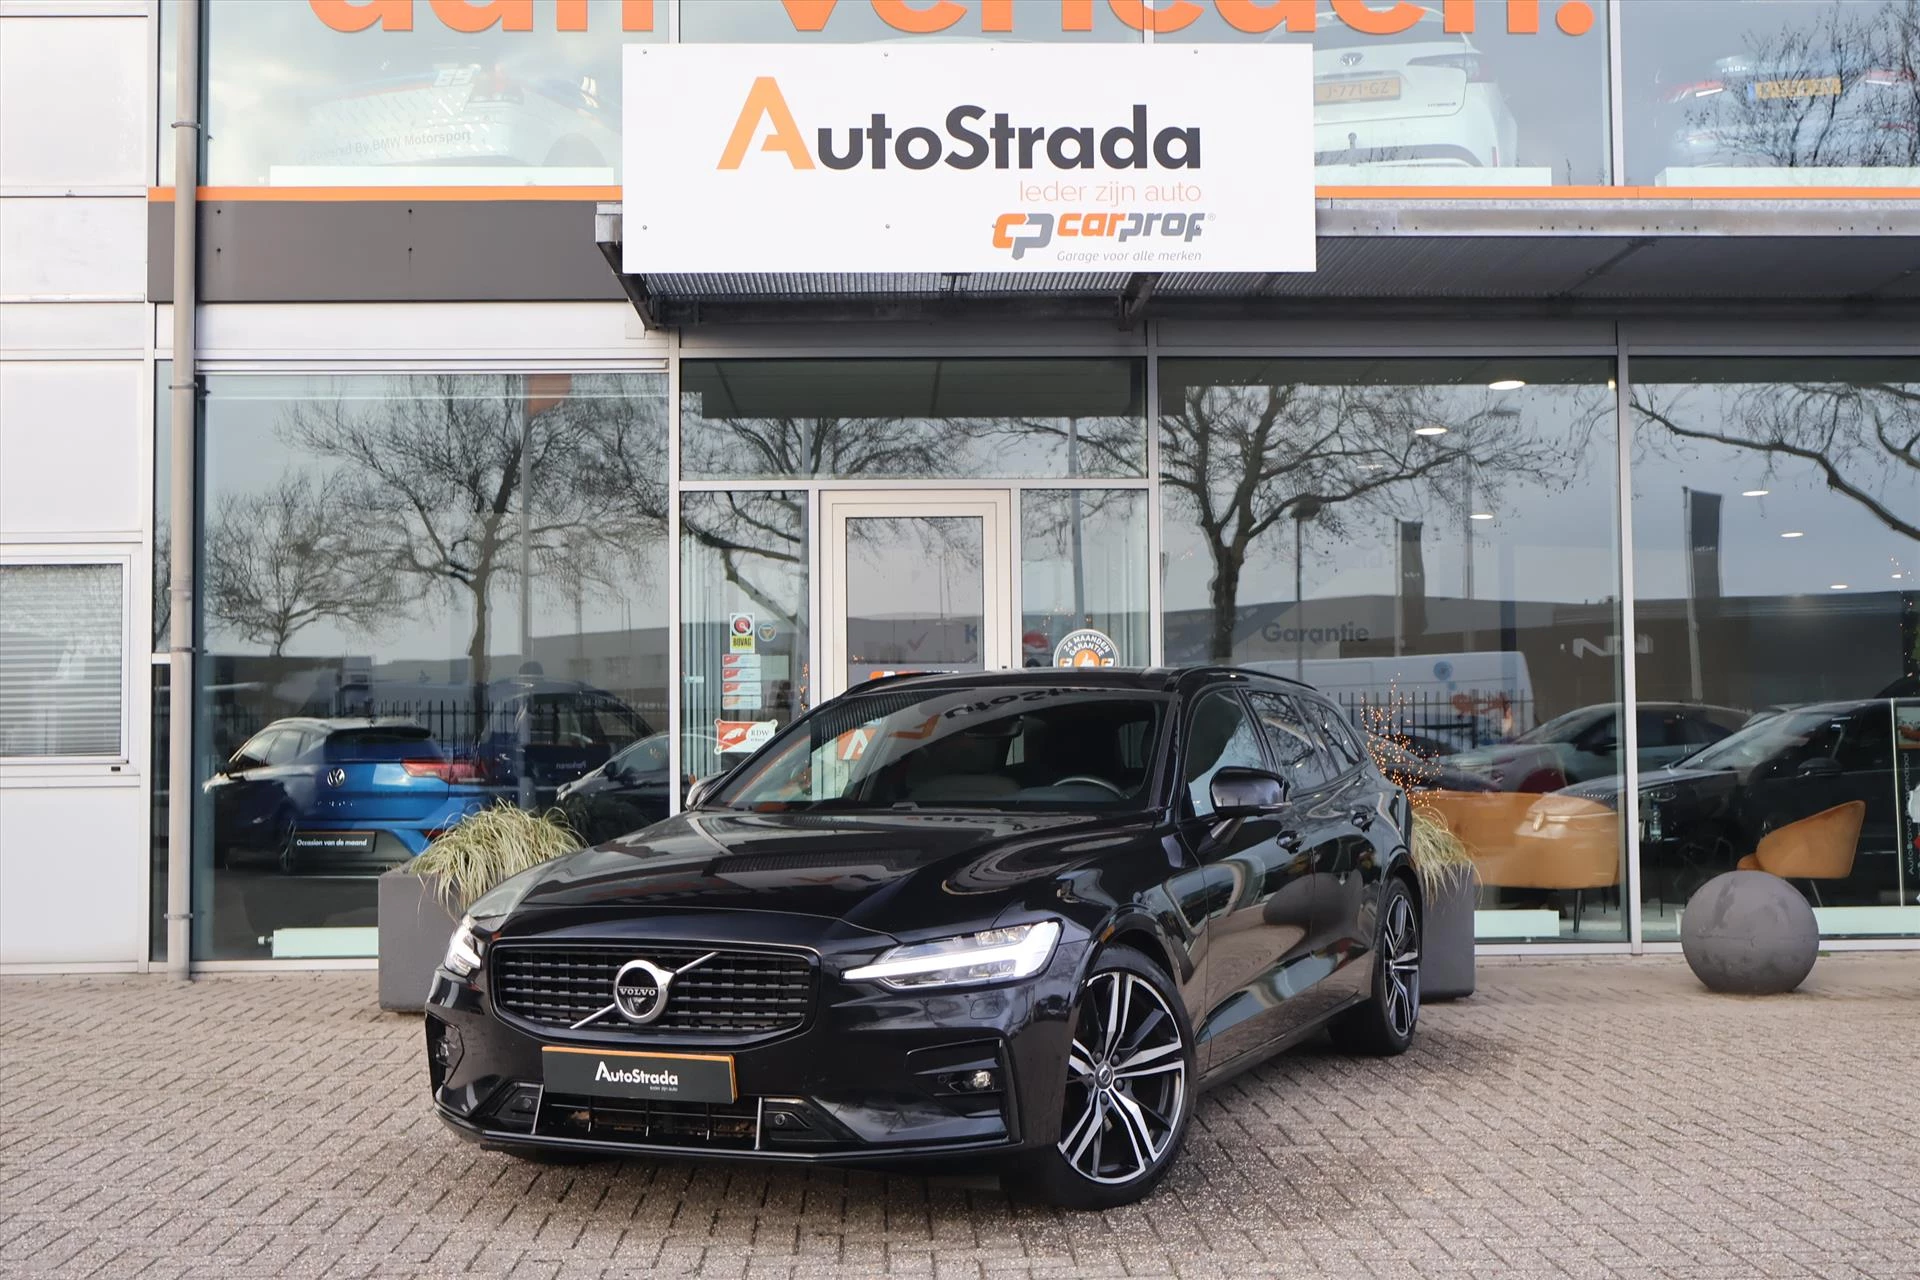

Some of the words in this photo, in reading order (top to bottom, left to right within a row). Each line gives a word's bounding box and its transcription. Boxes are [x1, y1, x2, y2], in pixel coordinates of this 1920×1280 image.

[717, 76, 1202, 170] AutoStrada
[373, 137, 401, 151] BMW
[404, 131, 472, 146] Motorsport
[1019, 181, 1087, 202] Ieder
[1095, 182, 1136, 207] zijn
[1144, 184, 1202, 202] auto
[1057, 251, 1100, 264] Garage
[1103, 253, 1129, 262] voor
[1132, 250, 1154, 262] alle
[1158, 250, 1202, 262] merken
[1261, 621, 1369, 643] Garantie
[733, 637, 752, 647] BOVAG
[1063, 641, 1073, 652] 24
[1073, 635, 1111, 653] MAANDEN
[1068, 642, 1105, 657] GARANTIE
[336, 839, 344, 847] de
[345, 839, 368, 847] maand
[619, 988, 656, 997] VOLVO
[595, 1061, 678, 1086] AutoStrada
